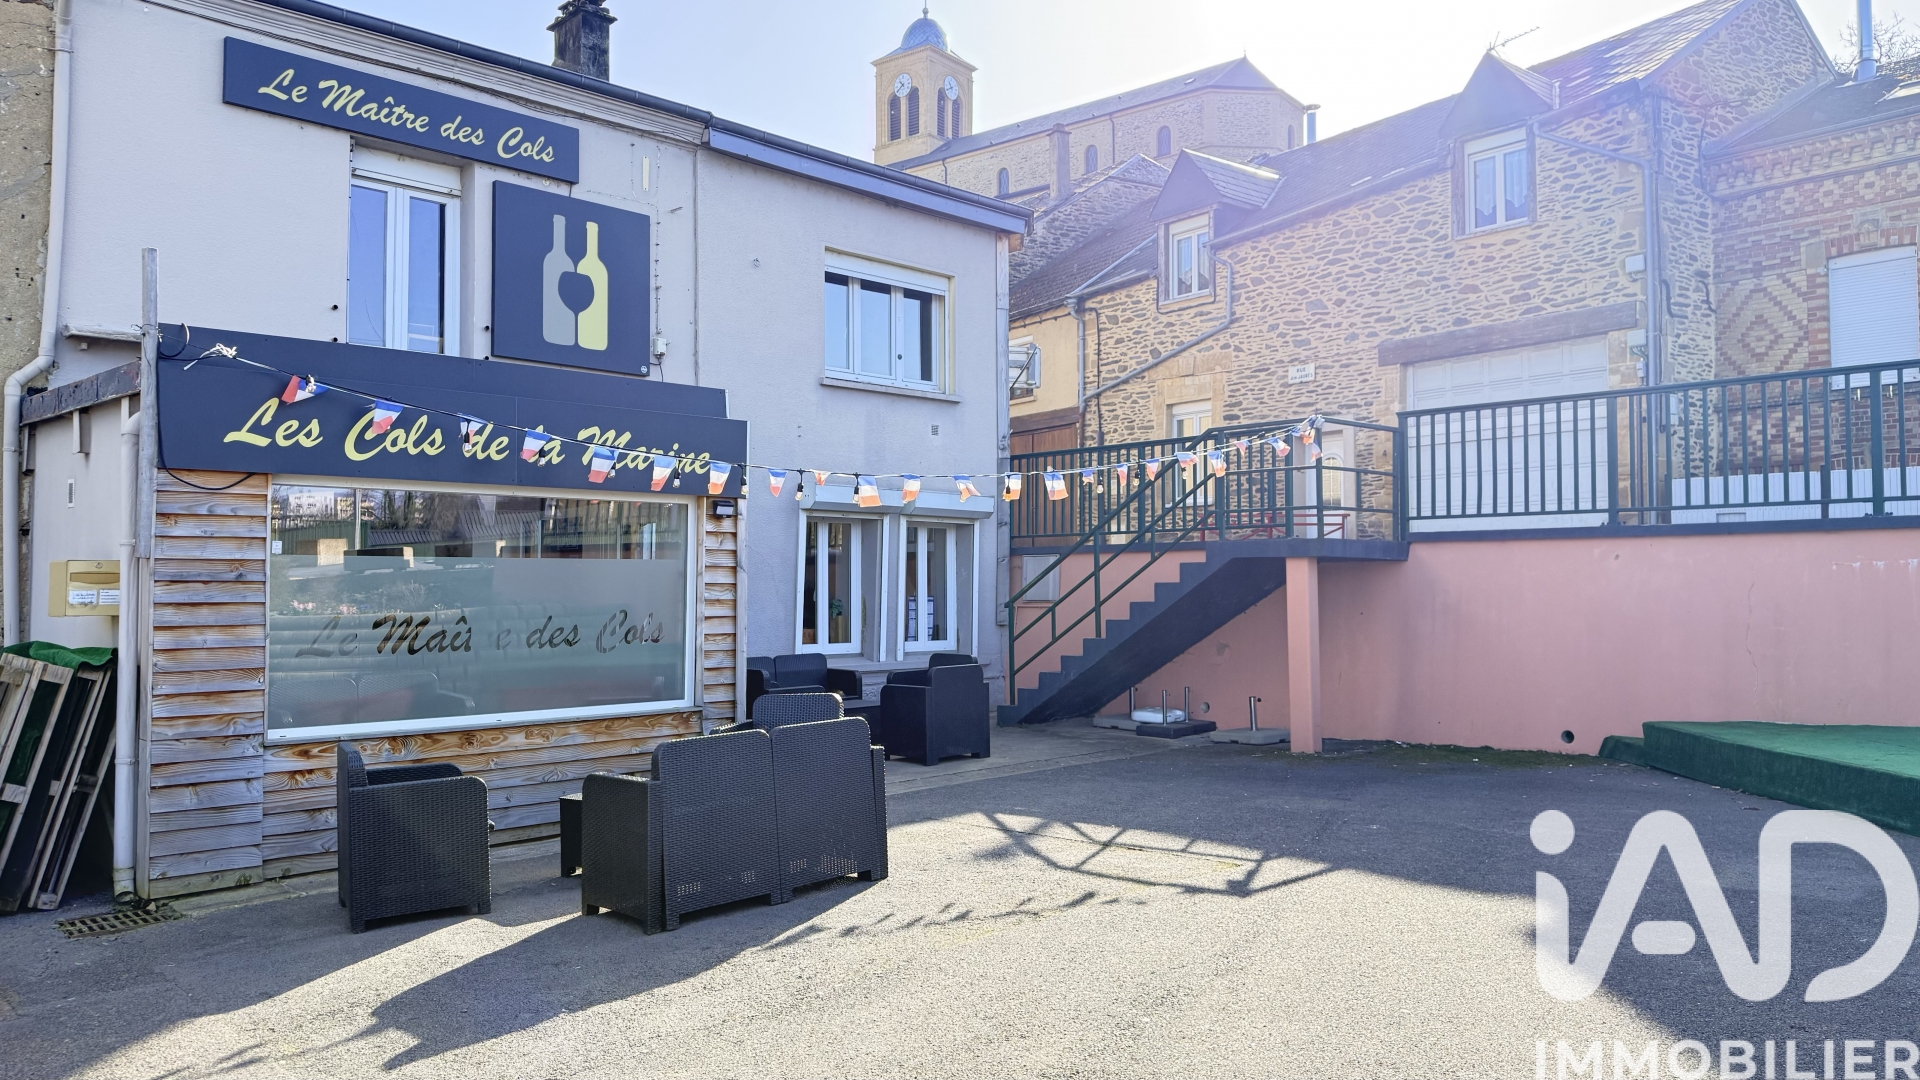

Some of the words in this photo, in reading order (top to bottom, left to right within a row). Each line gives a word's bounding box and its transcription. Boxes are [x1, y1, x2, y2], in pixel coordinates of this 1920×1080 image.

[258, 69, 307, 102] Le
[319, 79, 429, 132] Maître
[441, 115, 485, 145] des
[497, 126, 555, 163] Cols
[223, 397, 323, 448] Les
[344, 408, 446, 461] Cols
[463, 421, 510, 461] de
[527, 424, 565, 465] a
[295, 615, 358, 658] Le
[526, 615, 581, 650] des
[596, 609, 664, 654] Cols
